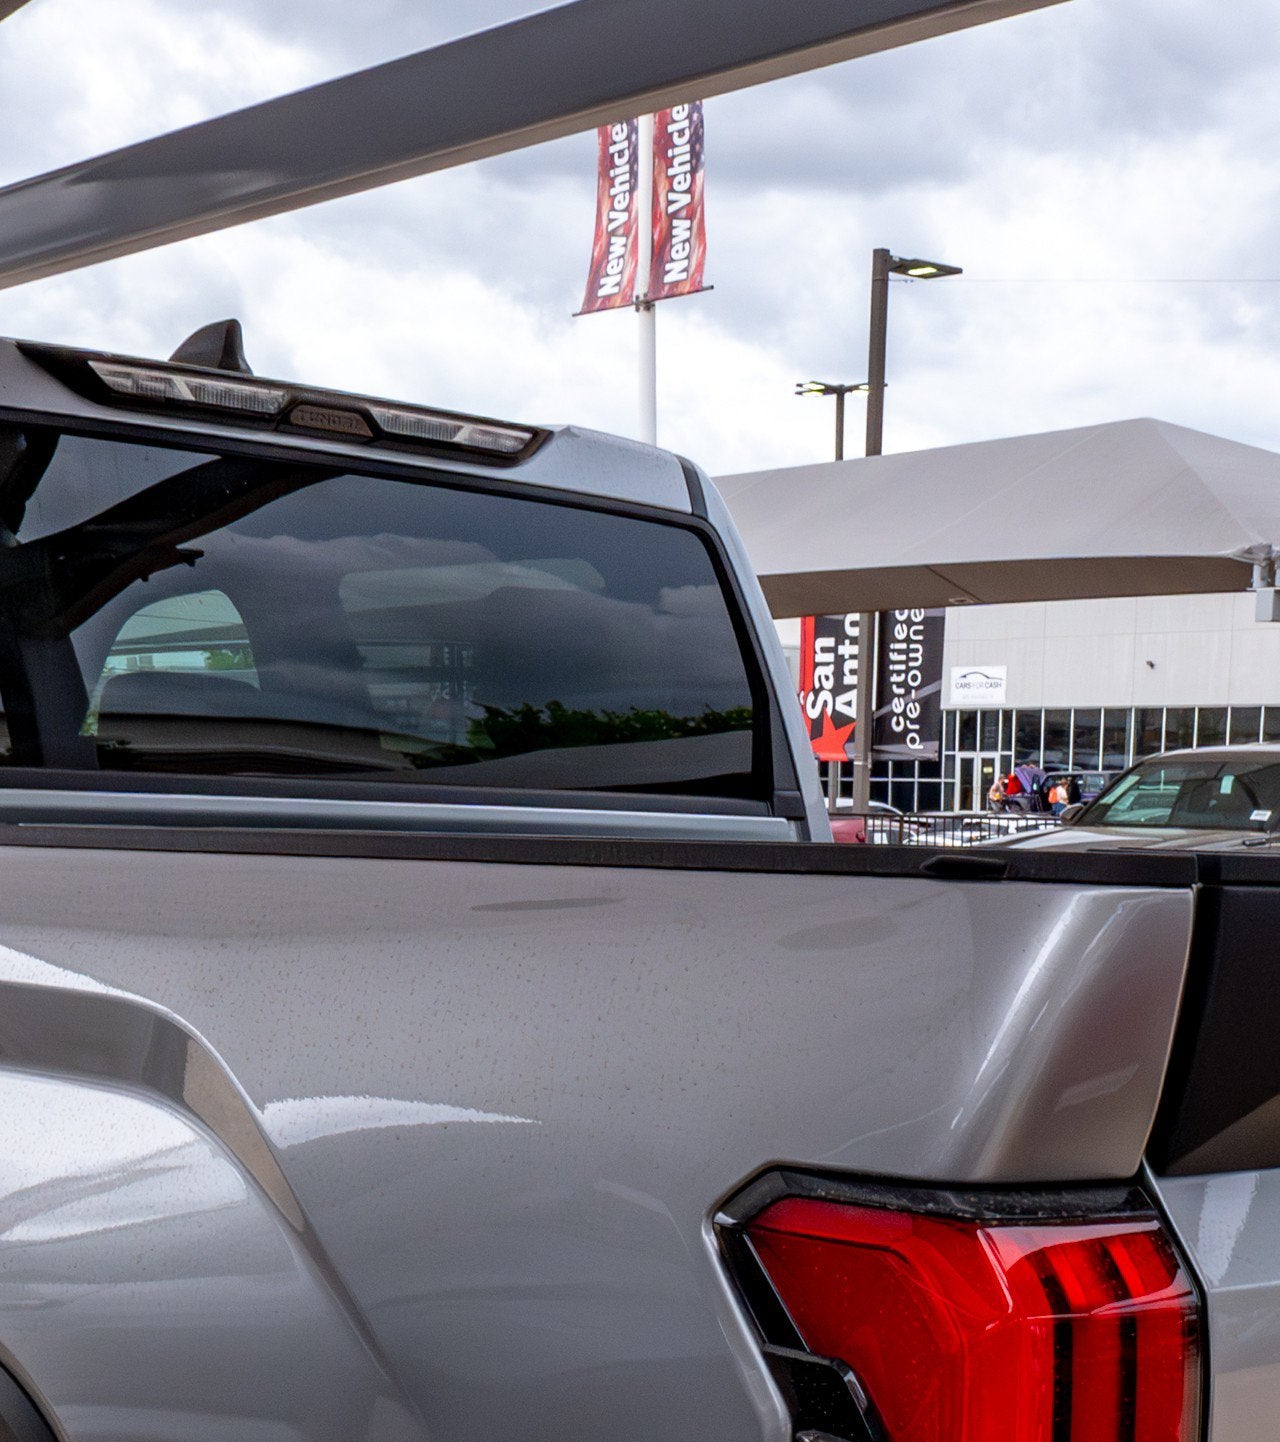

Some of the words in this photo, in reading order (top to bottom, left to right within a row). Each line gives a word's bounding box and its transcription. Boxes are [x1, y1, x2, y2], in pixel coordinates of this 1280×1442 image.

[667, 103, 692, 214] Vehicle
[598, 235, 628, 298] New
[663, 218, 692, 284] New
[806, 636, 836, 720] San
[954, 681, 971, 690] CARS
[984, 681, 1002, 689] CASH
